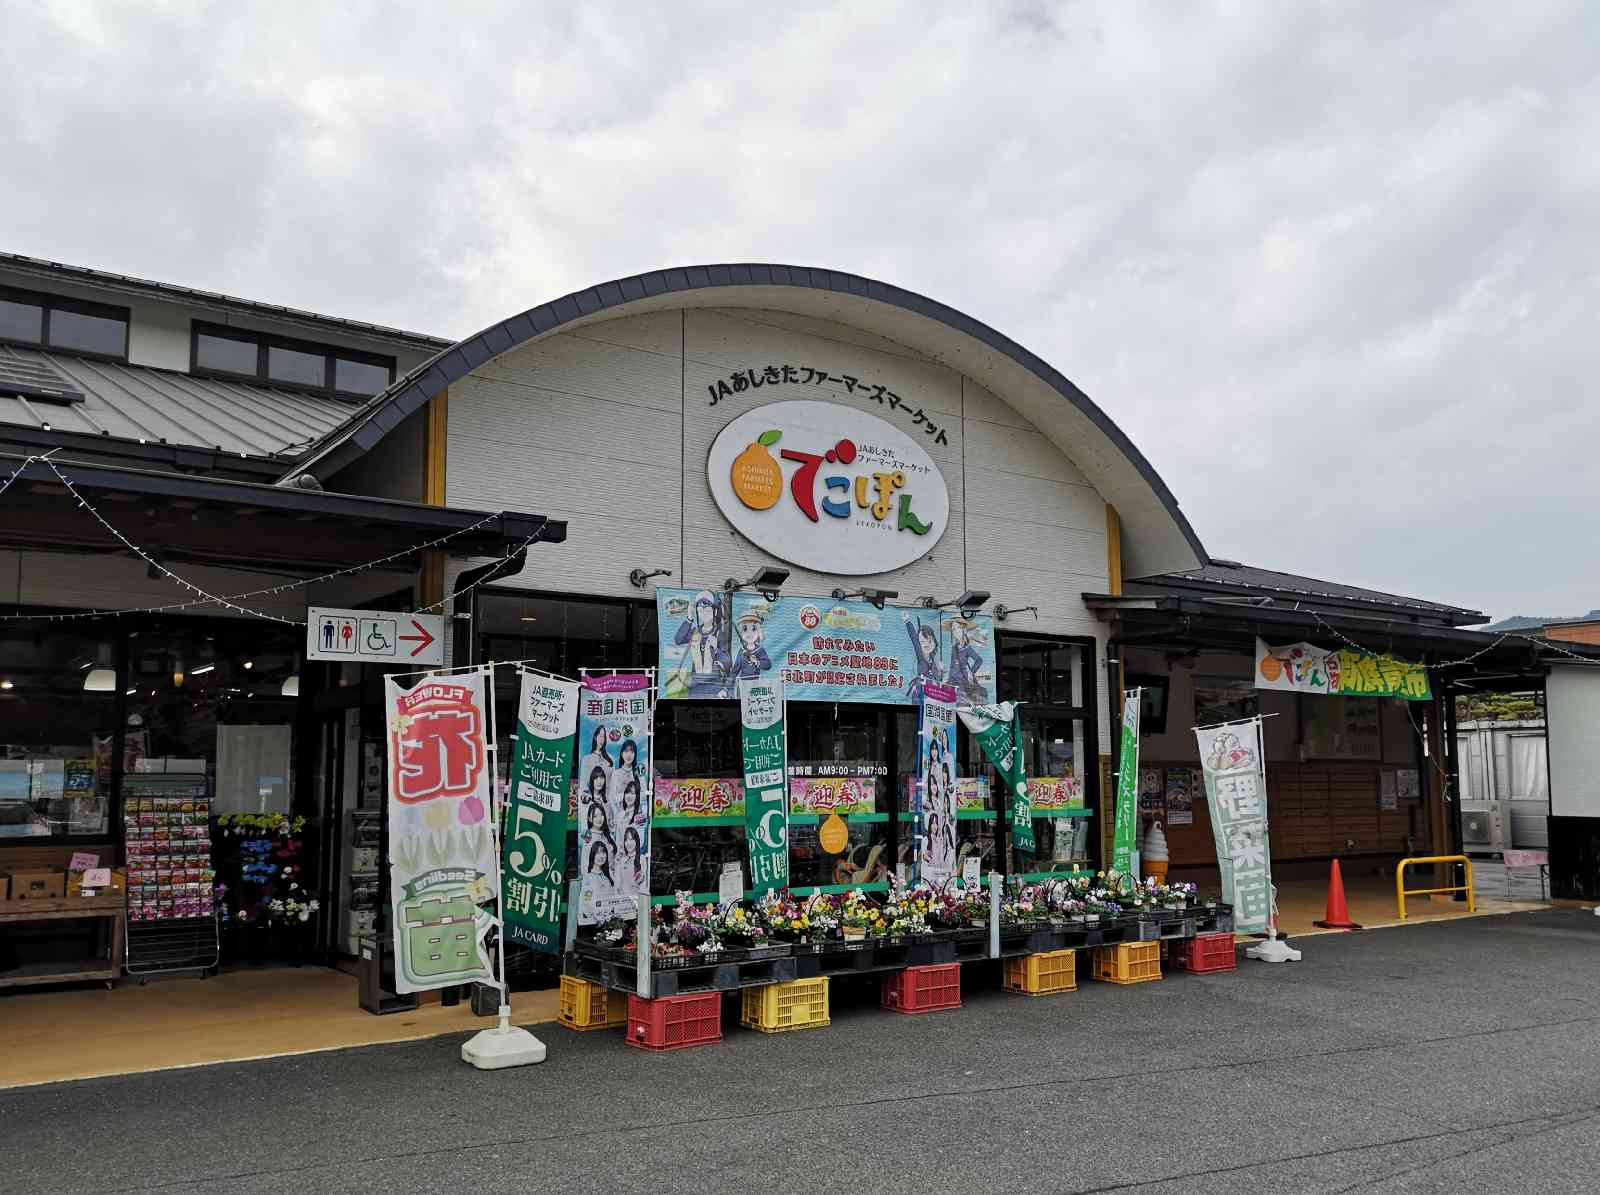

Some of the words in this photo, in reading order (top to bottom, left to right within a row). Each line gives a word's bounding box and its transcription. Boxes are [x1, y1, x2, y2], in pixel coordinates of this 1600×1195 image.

[708, 364, 948, 446] JAあしきたファーマーズマーケット
[780, 439, 933, 535] でこぽん
[532, 710, 560, 724] マーケット
[521, 741, 566, 768] JAカード
[520, 763, 563, 789] ご利用で
[818, 766, 849, 776] AM9:00
[857, 766, 888, 776] PM7:00
[680, 784, 729, 812] 迎春
[812, 783, 858, 811] 迎春
